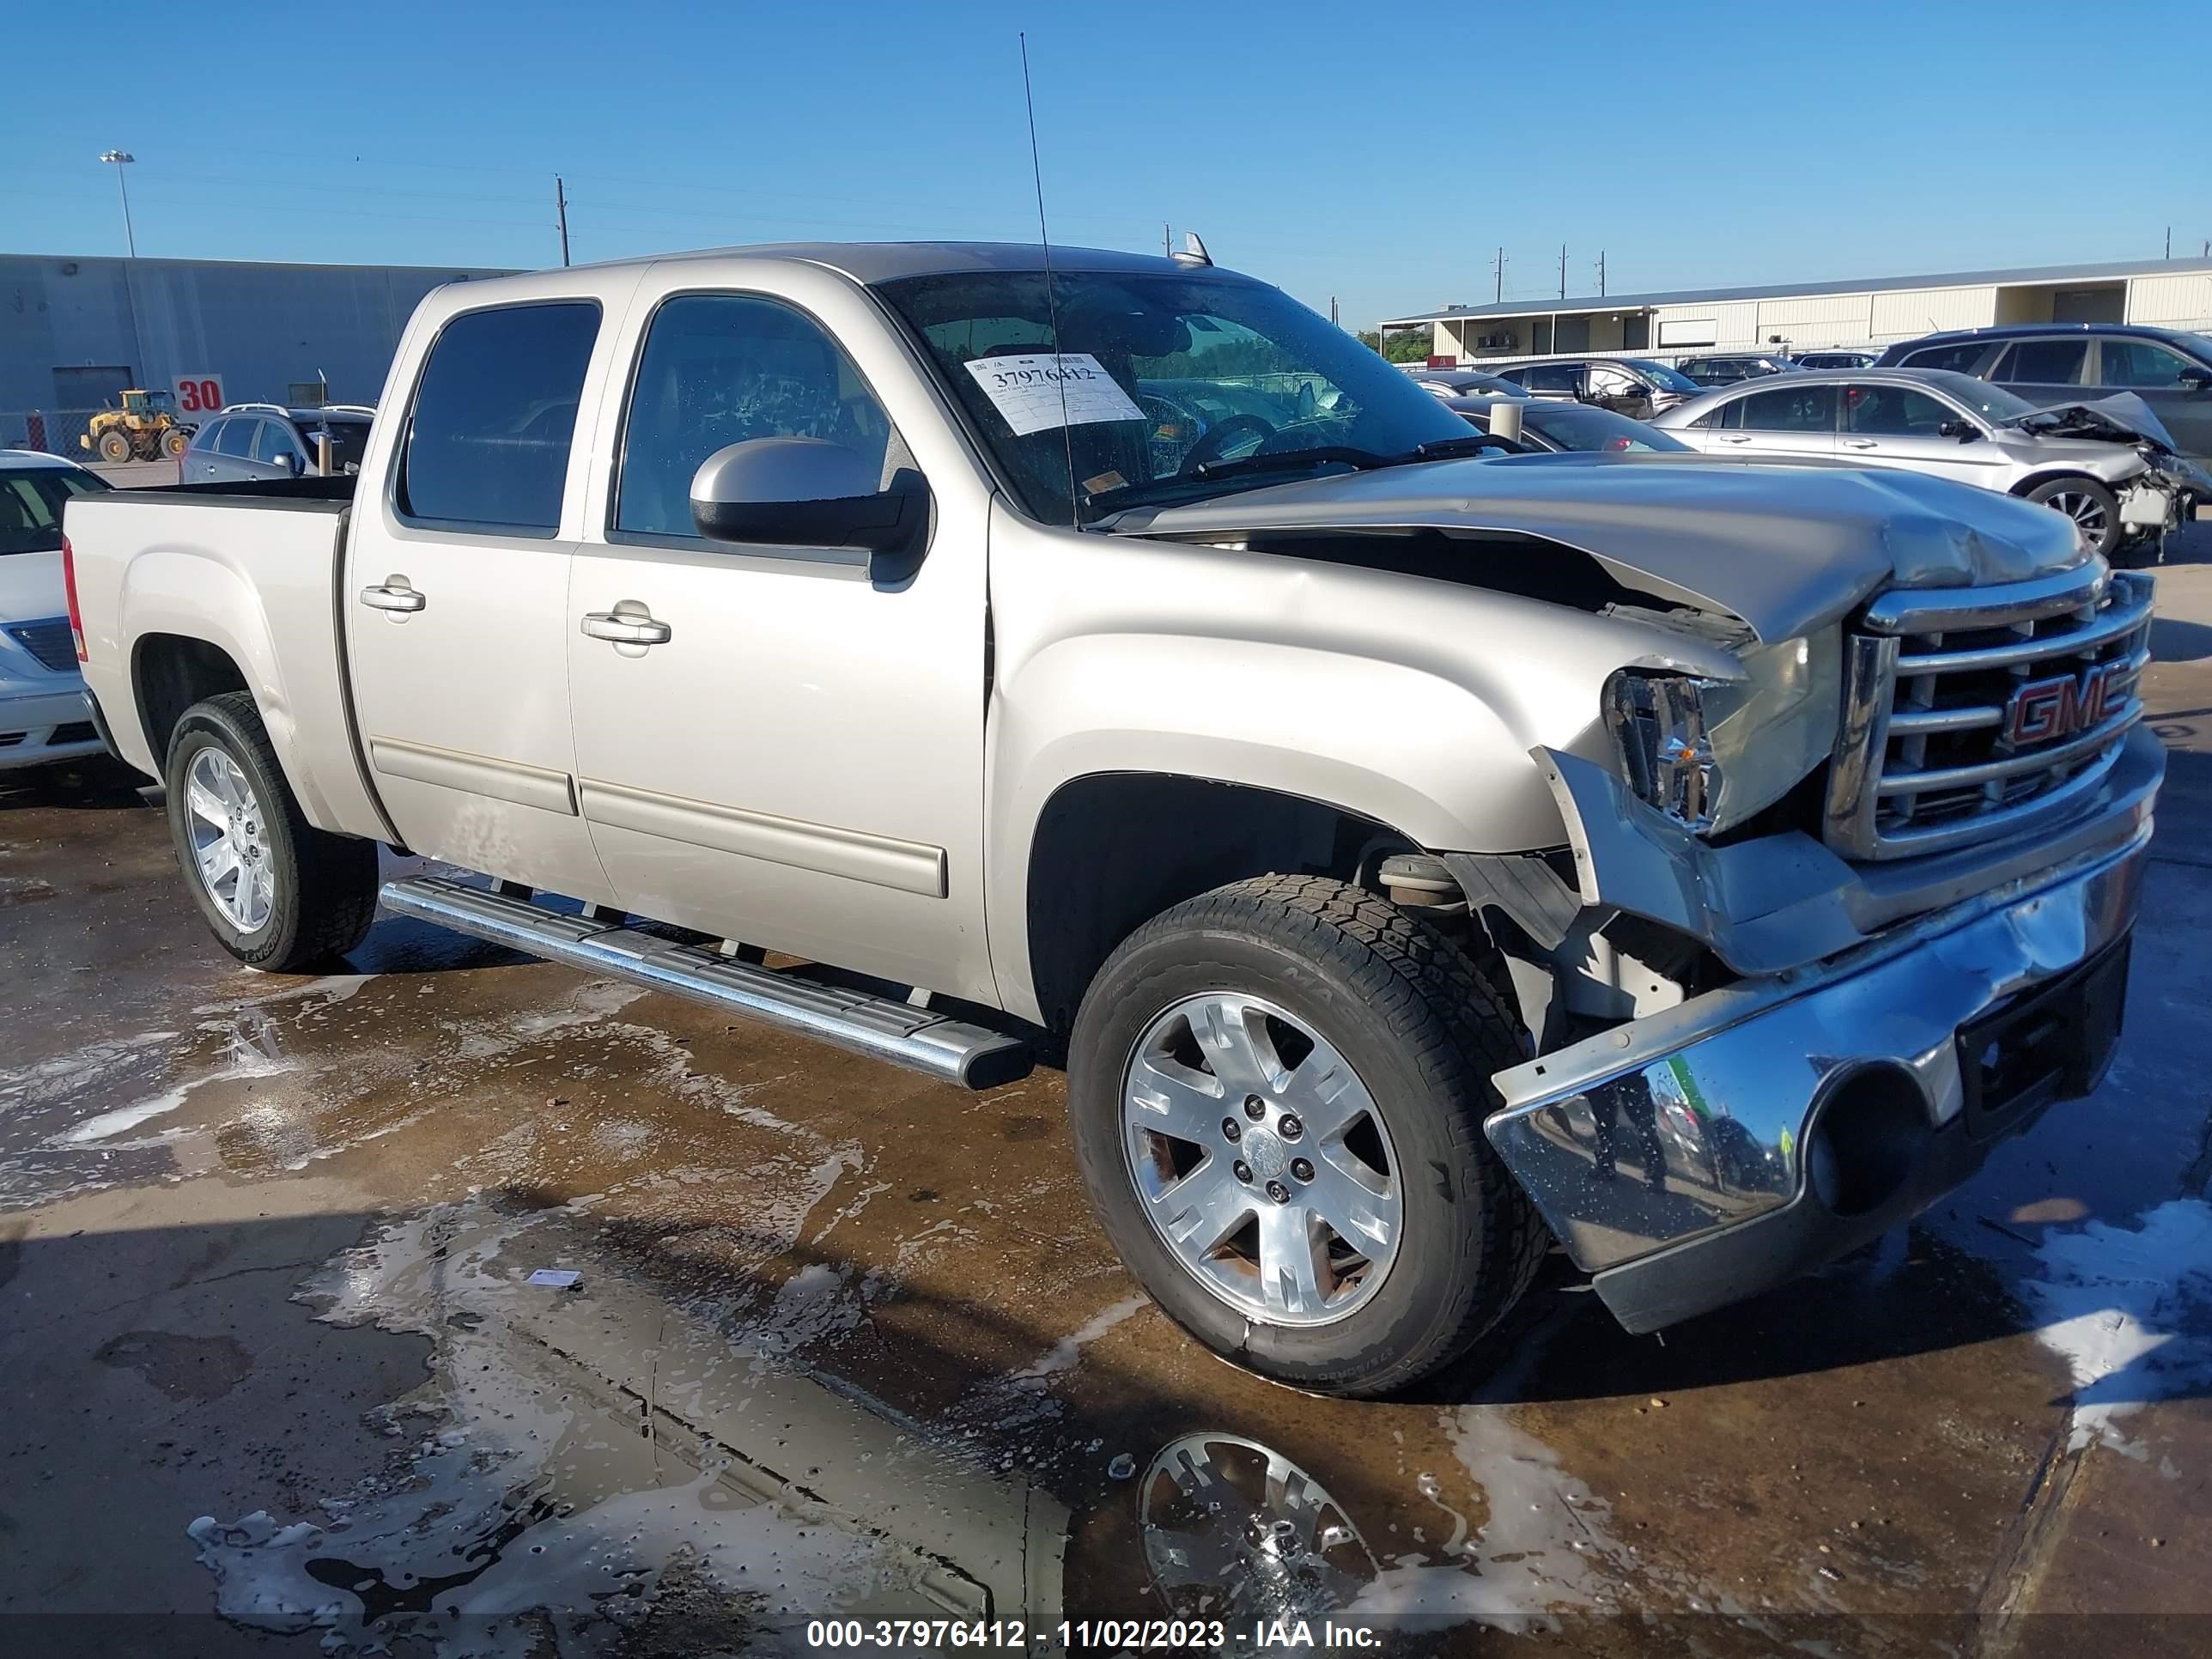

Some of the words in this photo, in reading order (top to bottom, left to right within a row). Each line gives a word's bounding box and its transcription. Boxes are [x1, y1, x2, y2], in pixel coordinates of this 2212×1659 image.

[992, 368, 1096, 387] 37976412
[179, 380, 221, 411] 30
[2006, 655, 2133, 745] GMC
